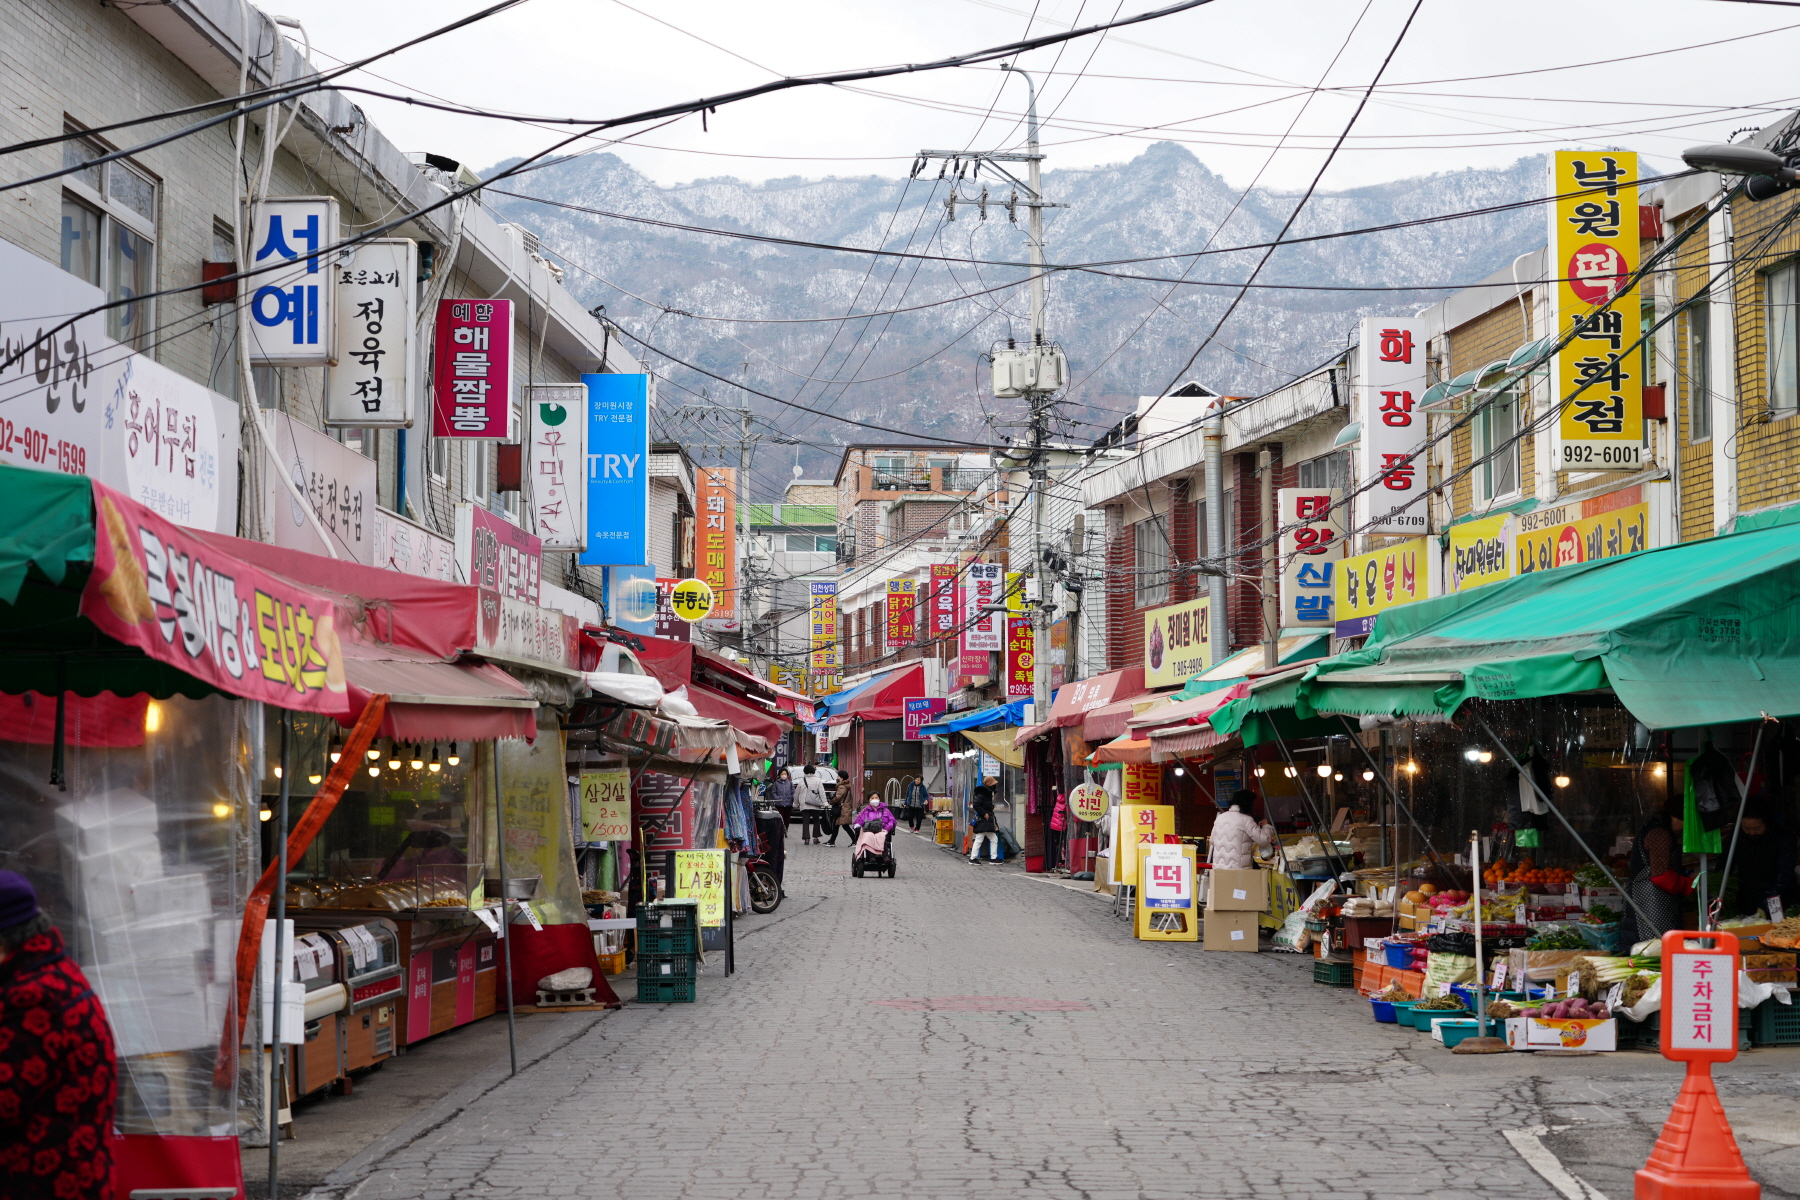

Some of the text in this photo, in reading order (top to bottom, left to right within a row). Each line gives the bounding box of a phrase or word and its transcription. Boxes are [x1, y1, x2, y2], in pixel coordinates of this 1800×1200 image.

[251, 214, 319, 345] 서예
[451, 303, 494, 322] 예향
[34, 321, 94, 414] 반찬
[348, 297, 387, 413] 정육점
[449, 326, 492, 431] 해물짬뽕
[593, 400, 633, 411] 장미원시장
[594, 412, 633, 423] TRY 전문점
[1378, 328, 1415, 491] 화장품
[0, 417, 86, 476] 02-907-1599
[125, 388, 198, 479] 홍어무침
[588, 453, 641, 479] TRY
[1563, 445, 1640, 464] 992-6001
[326, 478, 362, 542] 정육점
[1293, 496, 1335, 555] 태양
[1521, 507, 1567, 532] 992-6001
[672, 590, 711, 611] 부동산
[890, 580, 913, 592] 행운
[1295, 562, 1334, 622] 신발
[938, 578, 953, 630] 정육점
[240, 599, 259, 669] &
[1192, 606, 1208, 645] 치킨
[961, 655, 988, 664] 신라장식
[1009, 639, 1034, 651] 순대
[585, 782, 626, 803] 삼겹살
[1078, 798, 1101, 811] 치킨
[1125, 781, 1159, 800] 분식
[1153, 865, 1182, 894] 떡
[1691, 958, 1714, 1044] 주차금지
